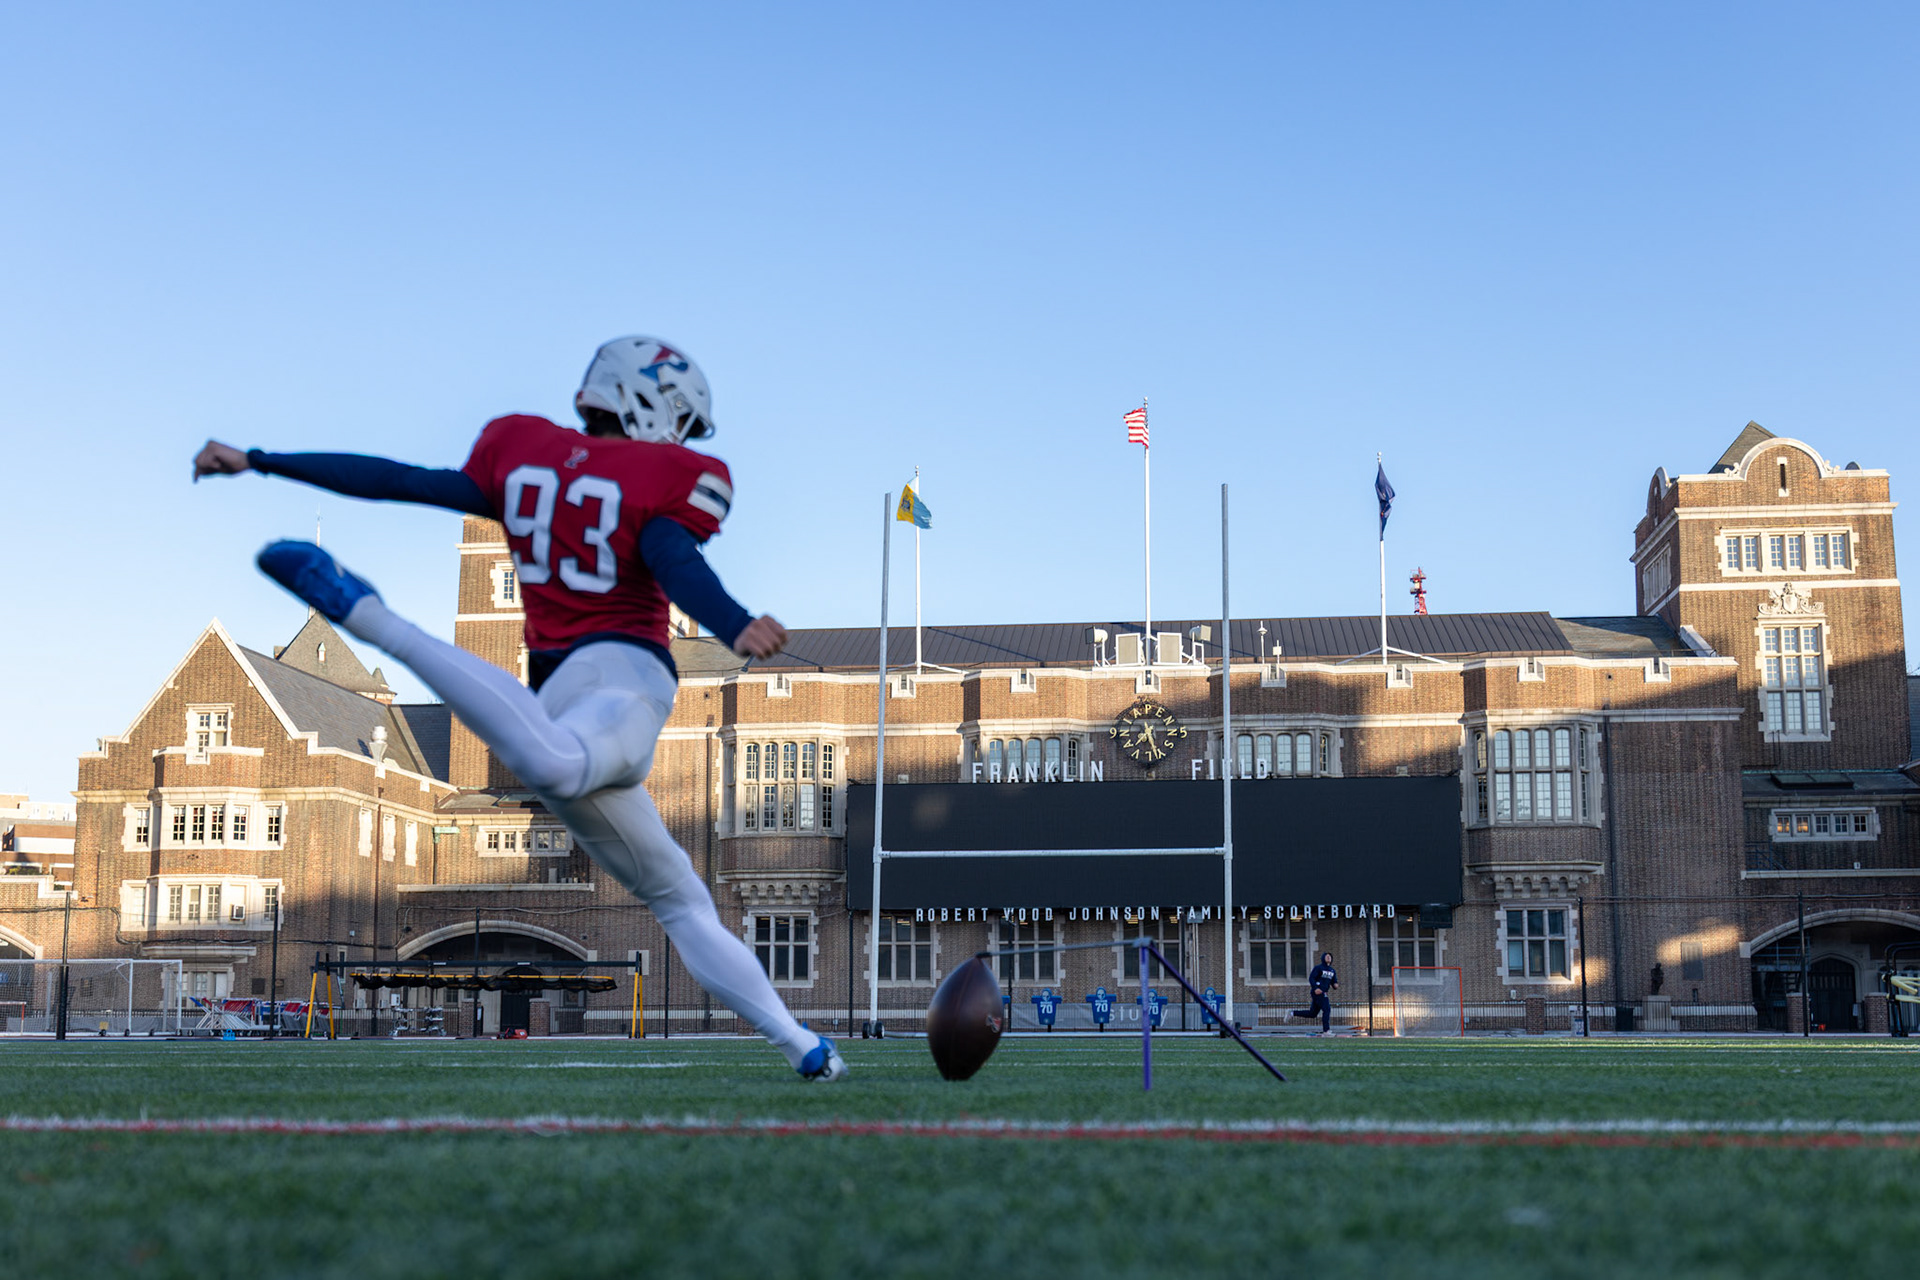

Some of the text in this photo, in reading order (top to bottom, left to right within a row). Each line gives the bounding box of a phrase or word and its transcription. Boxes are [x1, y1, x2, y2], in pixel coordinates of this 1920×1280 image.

[504, 464, 622, 594] 93
[1109, 727, 1118, 739] 9
[1179, 726, 1188, 739] 5
[972, 760, 1103, 783] FRANKLIN
[915, 903, 1395, 922] ROBERT WOOD JOHNSON FAMIY SCOREBOARD
[1040, 1004, 1053, 1014] 70
[1095, 1002, 1108, 1013] 70
[1109, 1006, 1168, 1027] stuy
